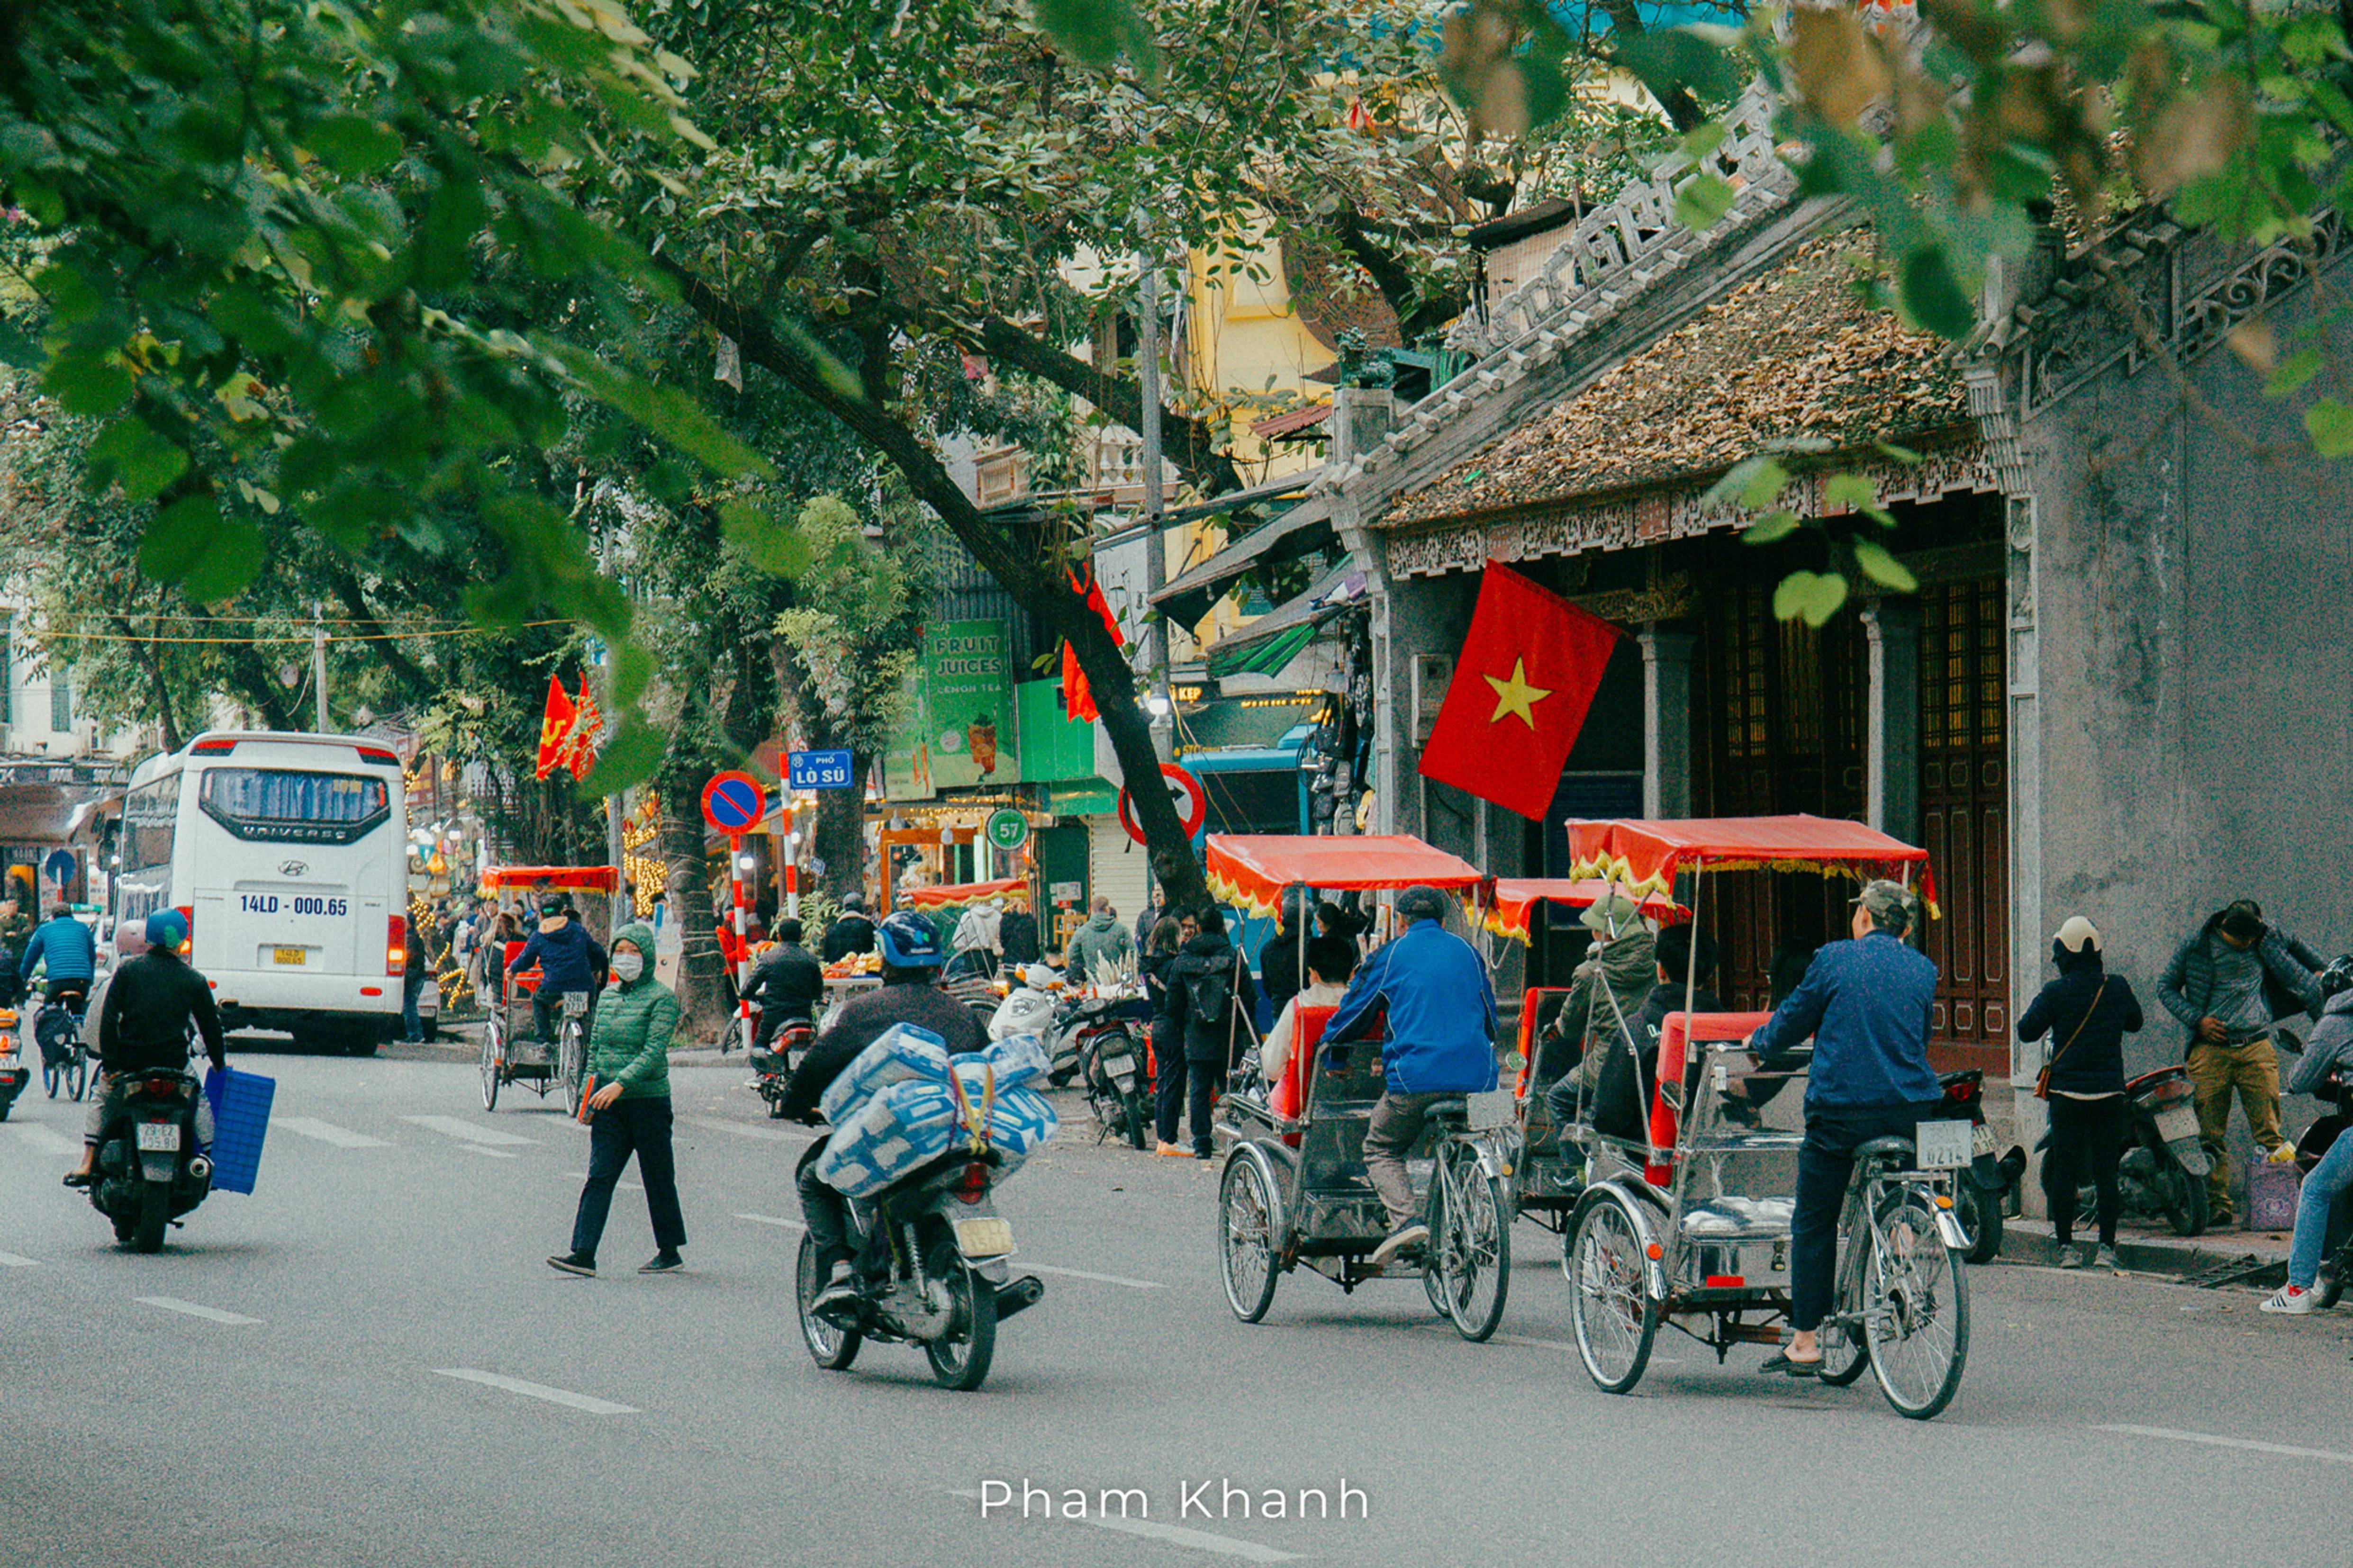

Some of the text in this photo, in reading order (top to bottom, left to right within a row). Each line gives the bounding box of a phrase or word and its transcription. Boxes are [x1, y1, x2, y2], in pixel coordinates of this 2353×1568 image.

[935, 635, 999, 653] FRUIT
[936, 658, 1002, 675] JUICES
[937, 684, 1002, 694] LEMON TEA
[815, 753, 835, 764] PHỐ
[796, 766, 845, 784] LÒ SŨ
[243, 825, 346, 840] UNIVERSE
[1000, 823, 1019, 838] 57
[241, 894, 278, 913] 14LD
[294, 897, 347, 917] 000.65
